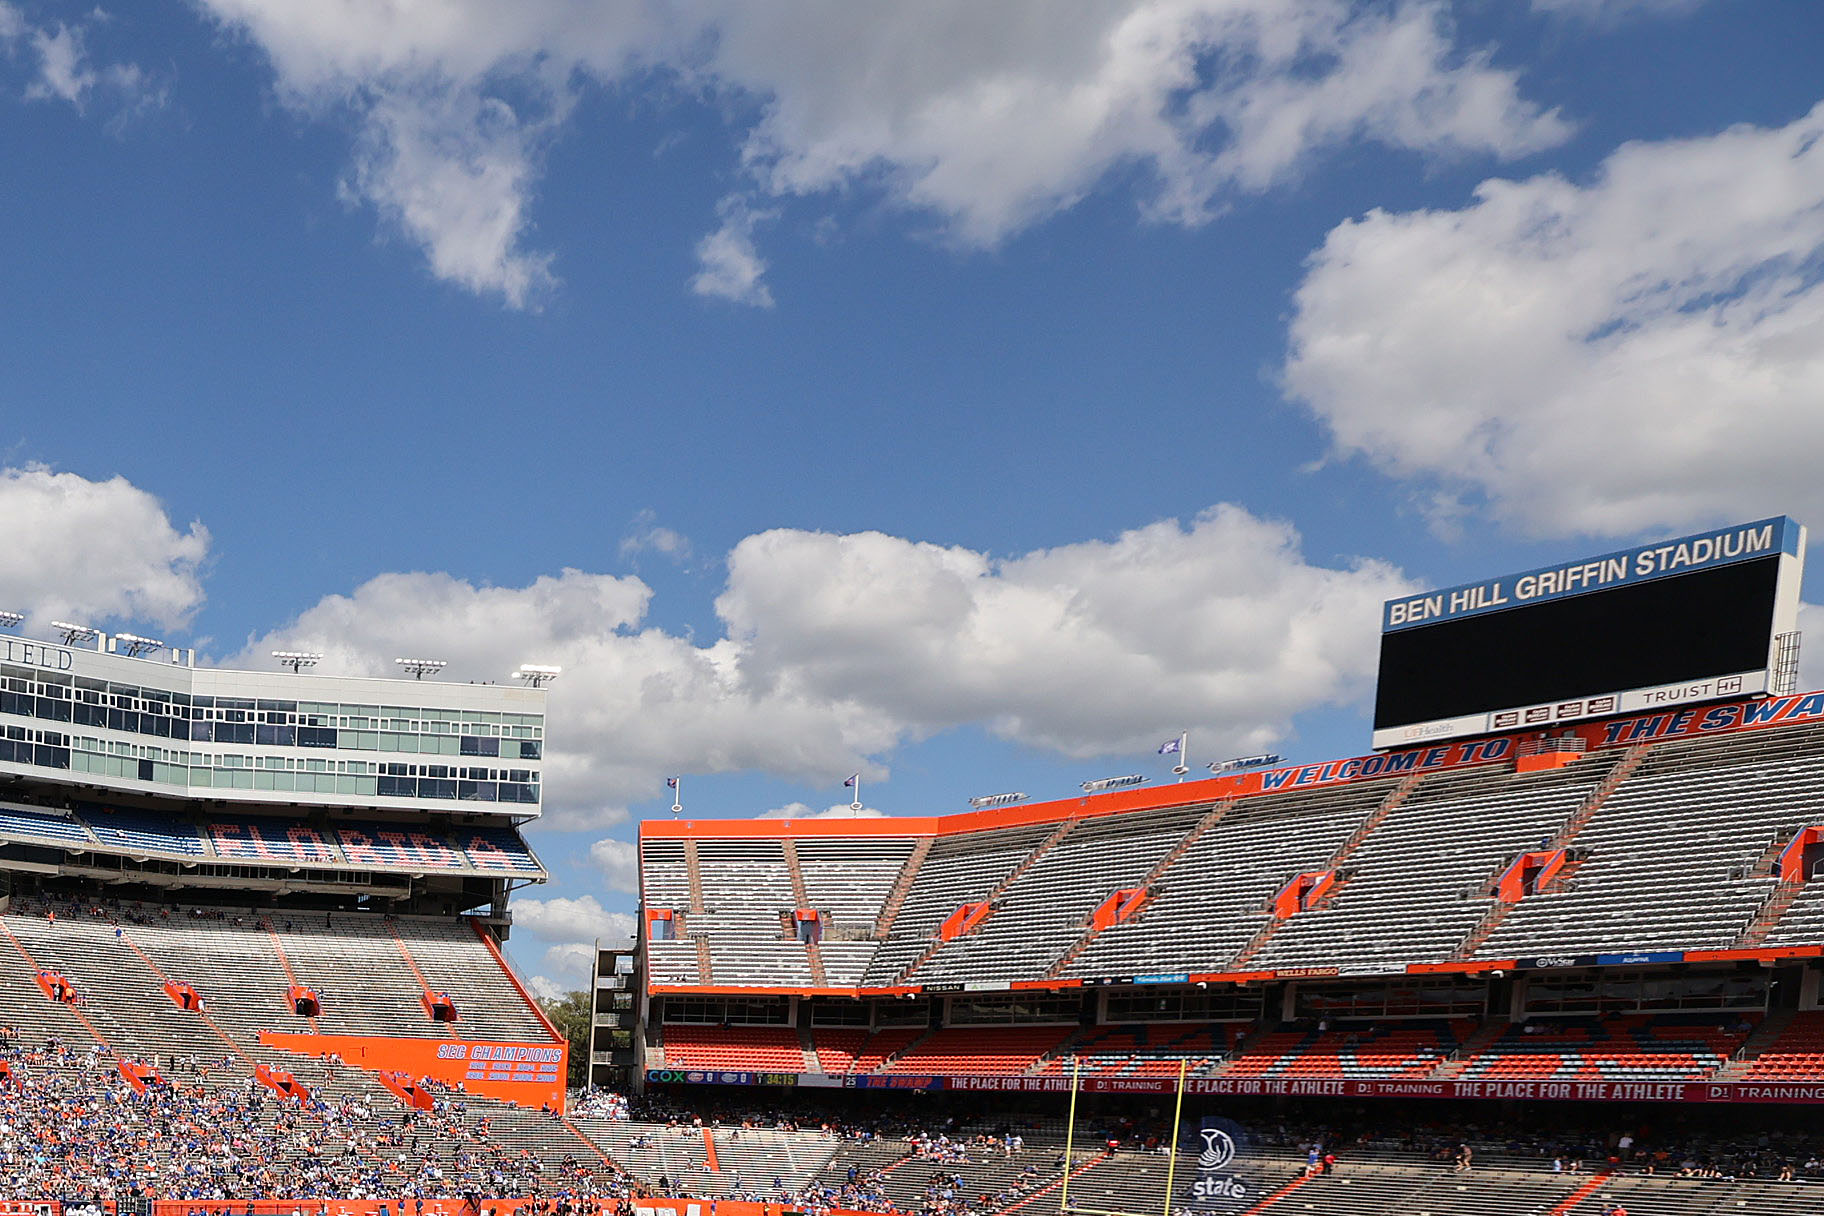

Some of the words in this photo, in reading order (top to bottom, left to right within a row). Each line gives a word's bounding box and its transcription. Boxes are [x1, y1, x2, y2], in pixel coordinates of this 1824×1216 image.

[1388, 599, 1442, 626] BEN
[1449, 582, 1508, 614] HILL
[1514, 556, 1630, 601] GRIFFIN
[1634, 524, 1774, 576] STADIUM
[1643, 684, 1713, 704] TRUIST
[1601, 710, 1688, 743] THE
[1260, 746, 1446, 791] WELCOME
[1456, 738, 1512, 763] TO
[1276, 968, 1307, 977] WELLS
[1307, 967, 1338, 976] FARGO
[437, 1044, 467, 1060] SEC
[470, 1045, 563, 1063] CHAMPIONS
[648, 1070, 685, 1083] COX
[766, 1073, 794, 1086] 34:15
[845, 1077, 856, 1087] 25
[889, 1077, 934, 1088] SWAMP
[951, 1077, 968, 1089] THE
[970, 1078, 1000, 1090] PLACE
[1002, 1078, 1021, 1090] FOR
[1023, 1078, 1042, 1090] THE
[1043, 1079, 1085, 1091] ATHLETE
[1112, 1081, 1162, 1090] TRAINING
[1172, 1080, 1194, 1092] THE
[1196, 1080, 1234, 1093] PLACE
[1237, 1081, 1261, 1094] FOR
[1265, 1081, 1287, 1094] THE
[1290, 1082, 1345, 1095] ATHLETE
[1378, 1084, 1443, 1094] TRAINING
[1454, 1083, 1481, 1097] THE
[1485, 1083, 1535, 1098] PLACE
[1538, 1084, 1571, 1098] FOR
[1577, 1084, 1607, 1099] THE
[1611, 1085, 1685, 1100] ATHLETE
[1738, 1088, 1824, 1099] TRAINING
[1193, 1176, 1246, 1199] state
